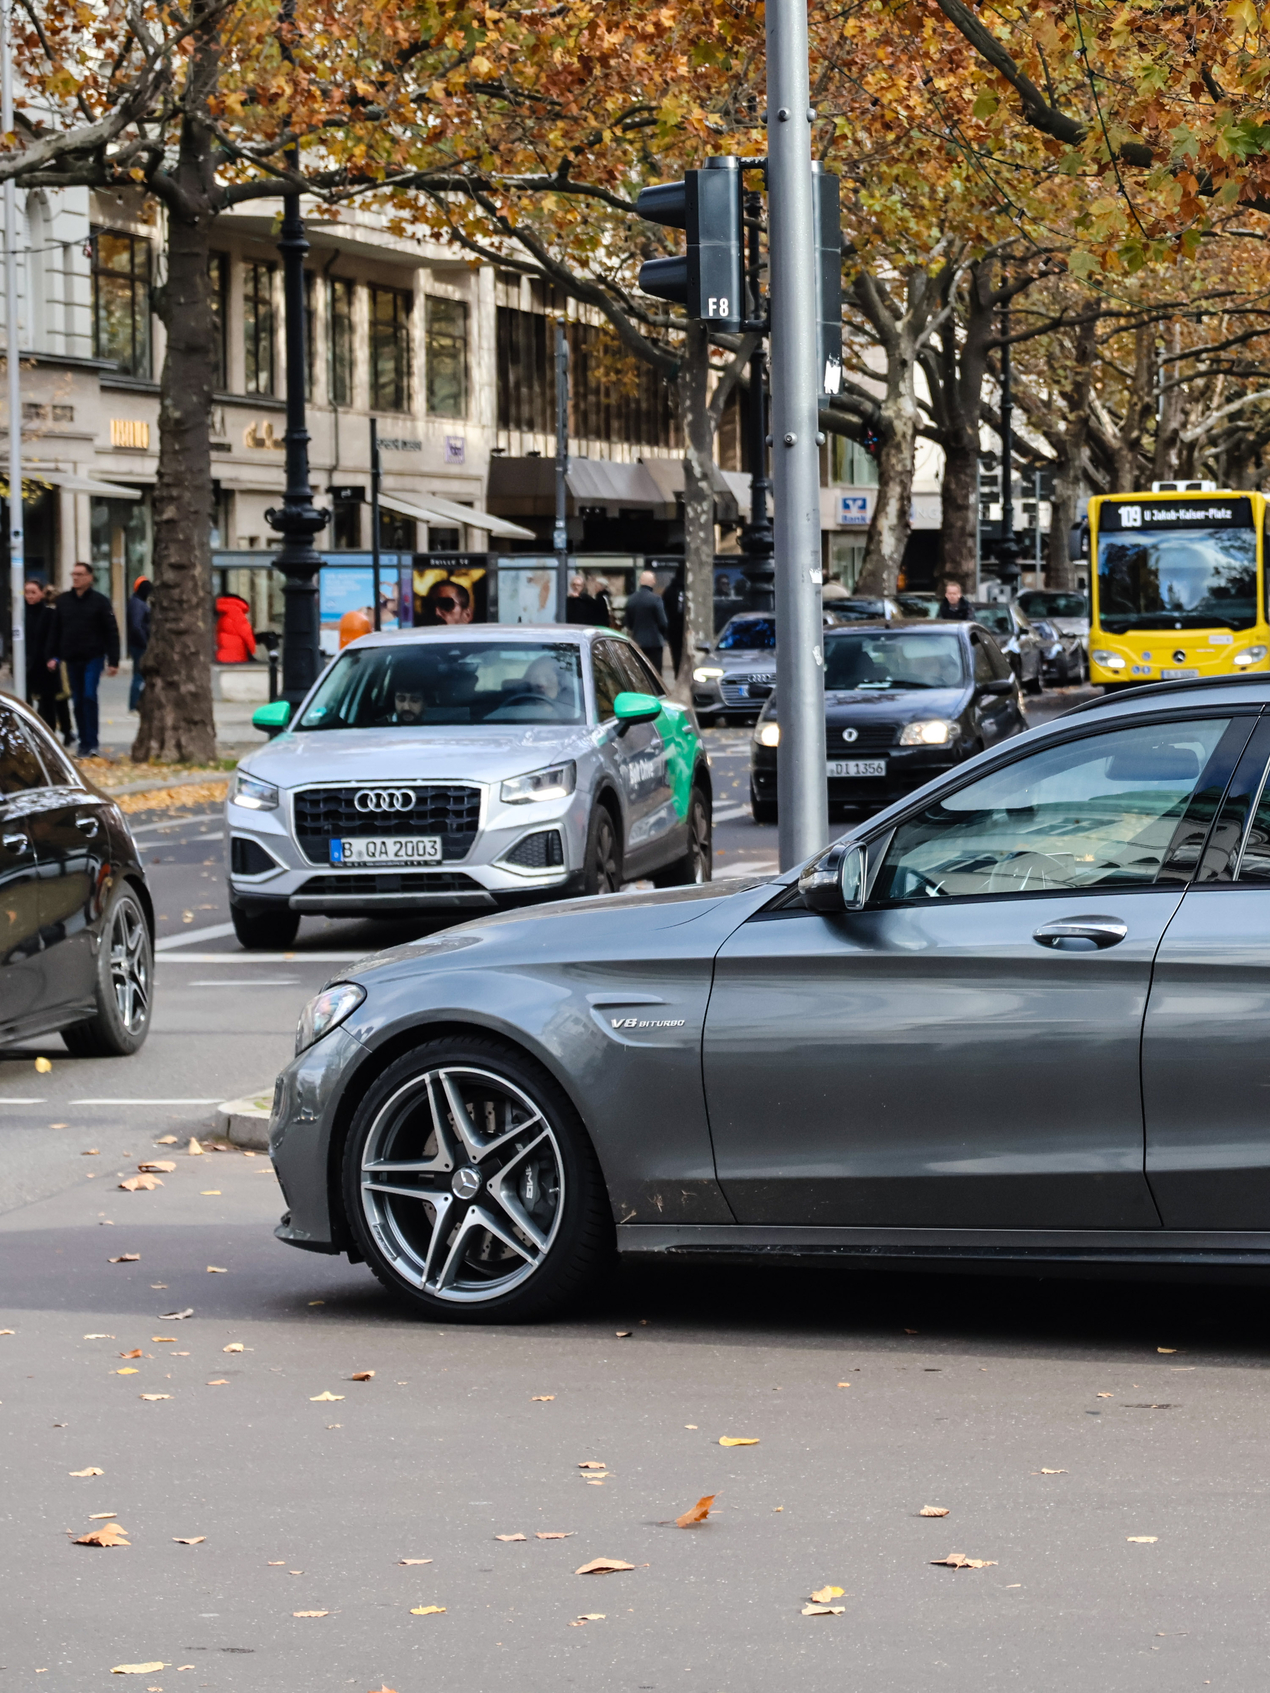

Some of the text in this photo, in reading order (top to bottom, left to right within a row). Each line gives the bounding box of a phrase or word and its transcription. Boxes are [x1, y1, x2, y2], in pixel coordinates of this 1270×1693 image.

[708, 297, 729, 317] F8
[841, 514, 867, 524] Bank
[1118, 506, 1232, 527] 109 U Jakob-Kaiser-Platz
[342, 840, 438, 858] B QA 2003
[610, 1018, 686, 1029] V8 BITURBO
